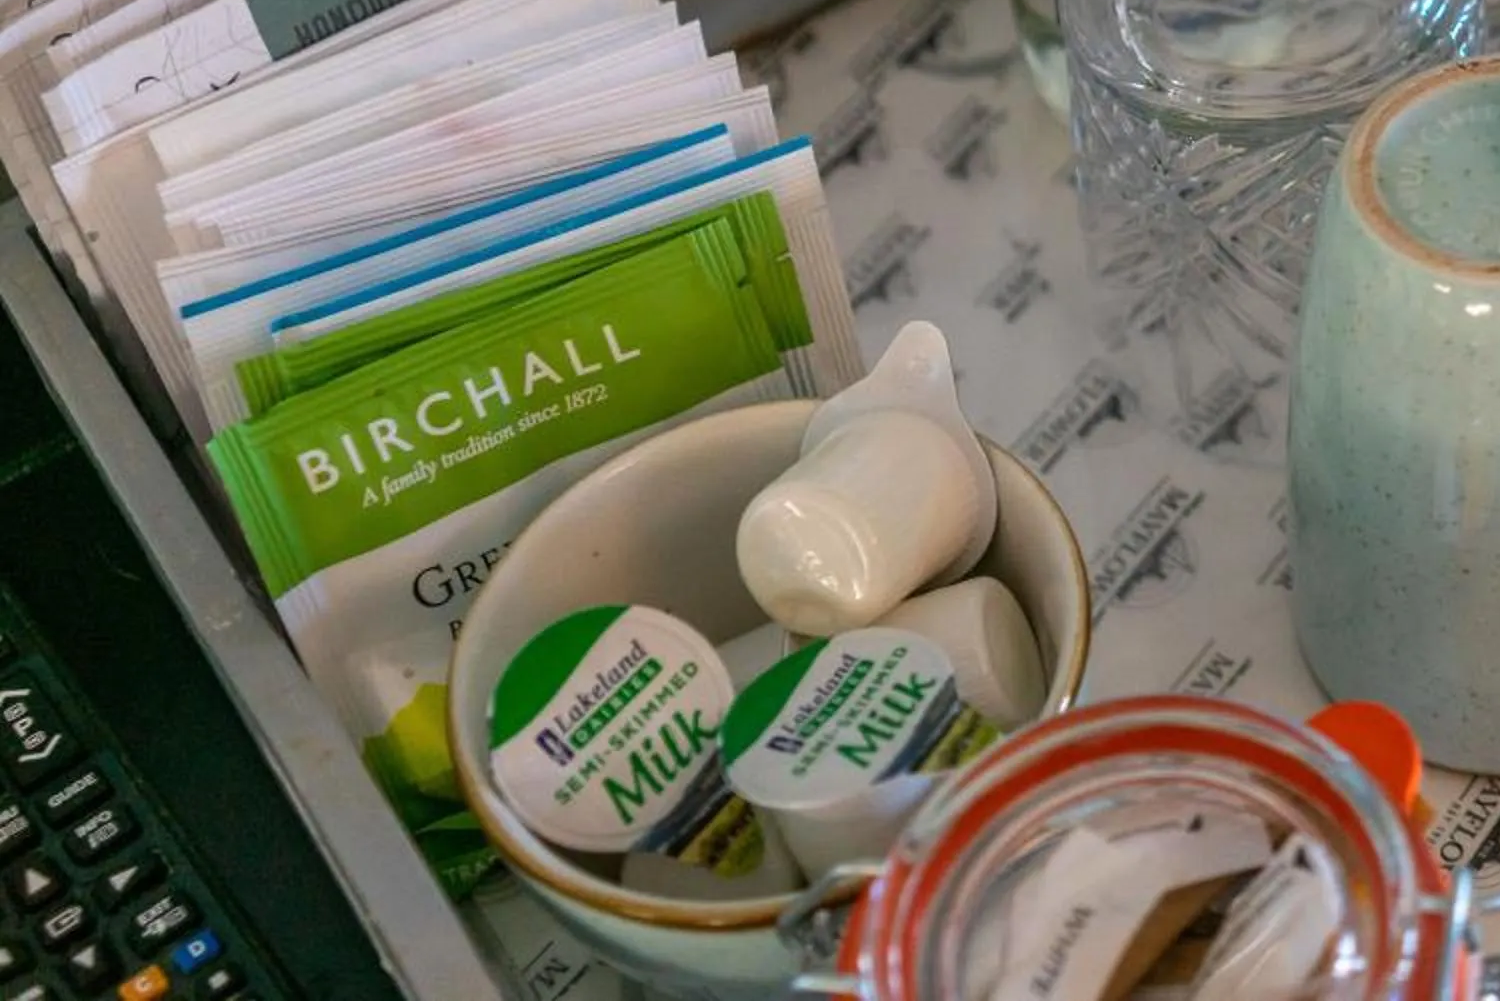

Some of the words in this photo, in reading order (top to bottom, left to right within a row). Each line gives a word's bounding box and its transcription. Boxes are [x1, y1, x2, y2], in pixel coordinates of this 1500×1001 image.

[296, 324, 641, 494] BIRCHALL
[362, 487, 379, 508] A
[381, 458, 437, 506] family
[441, 422, 515, 468] tradition
[517, 401, 560, 432] since
[564, 383, 609, 413] 1872
[412, 541, 512, 609] GRE
[553, 638, 648, 735] Lakeland
[554, 661, 699, 805] SEMI-SKIMMED
[836, 672, 937, 769] Milk
[47, 771, 98, 809] GUIDE
[603, 710, 718, 826] Milk
